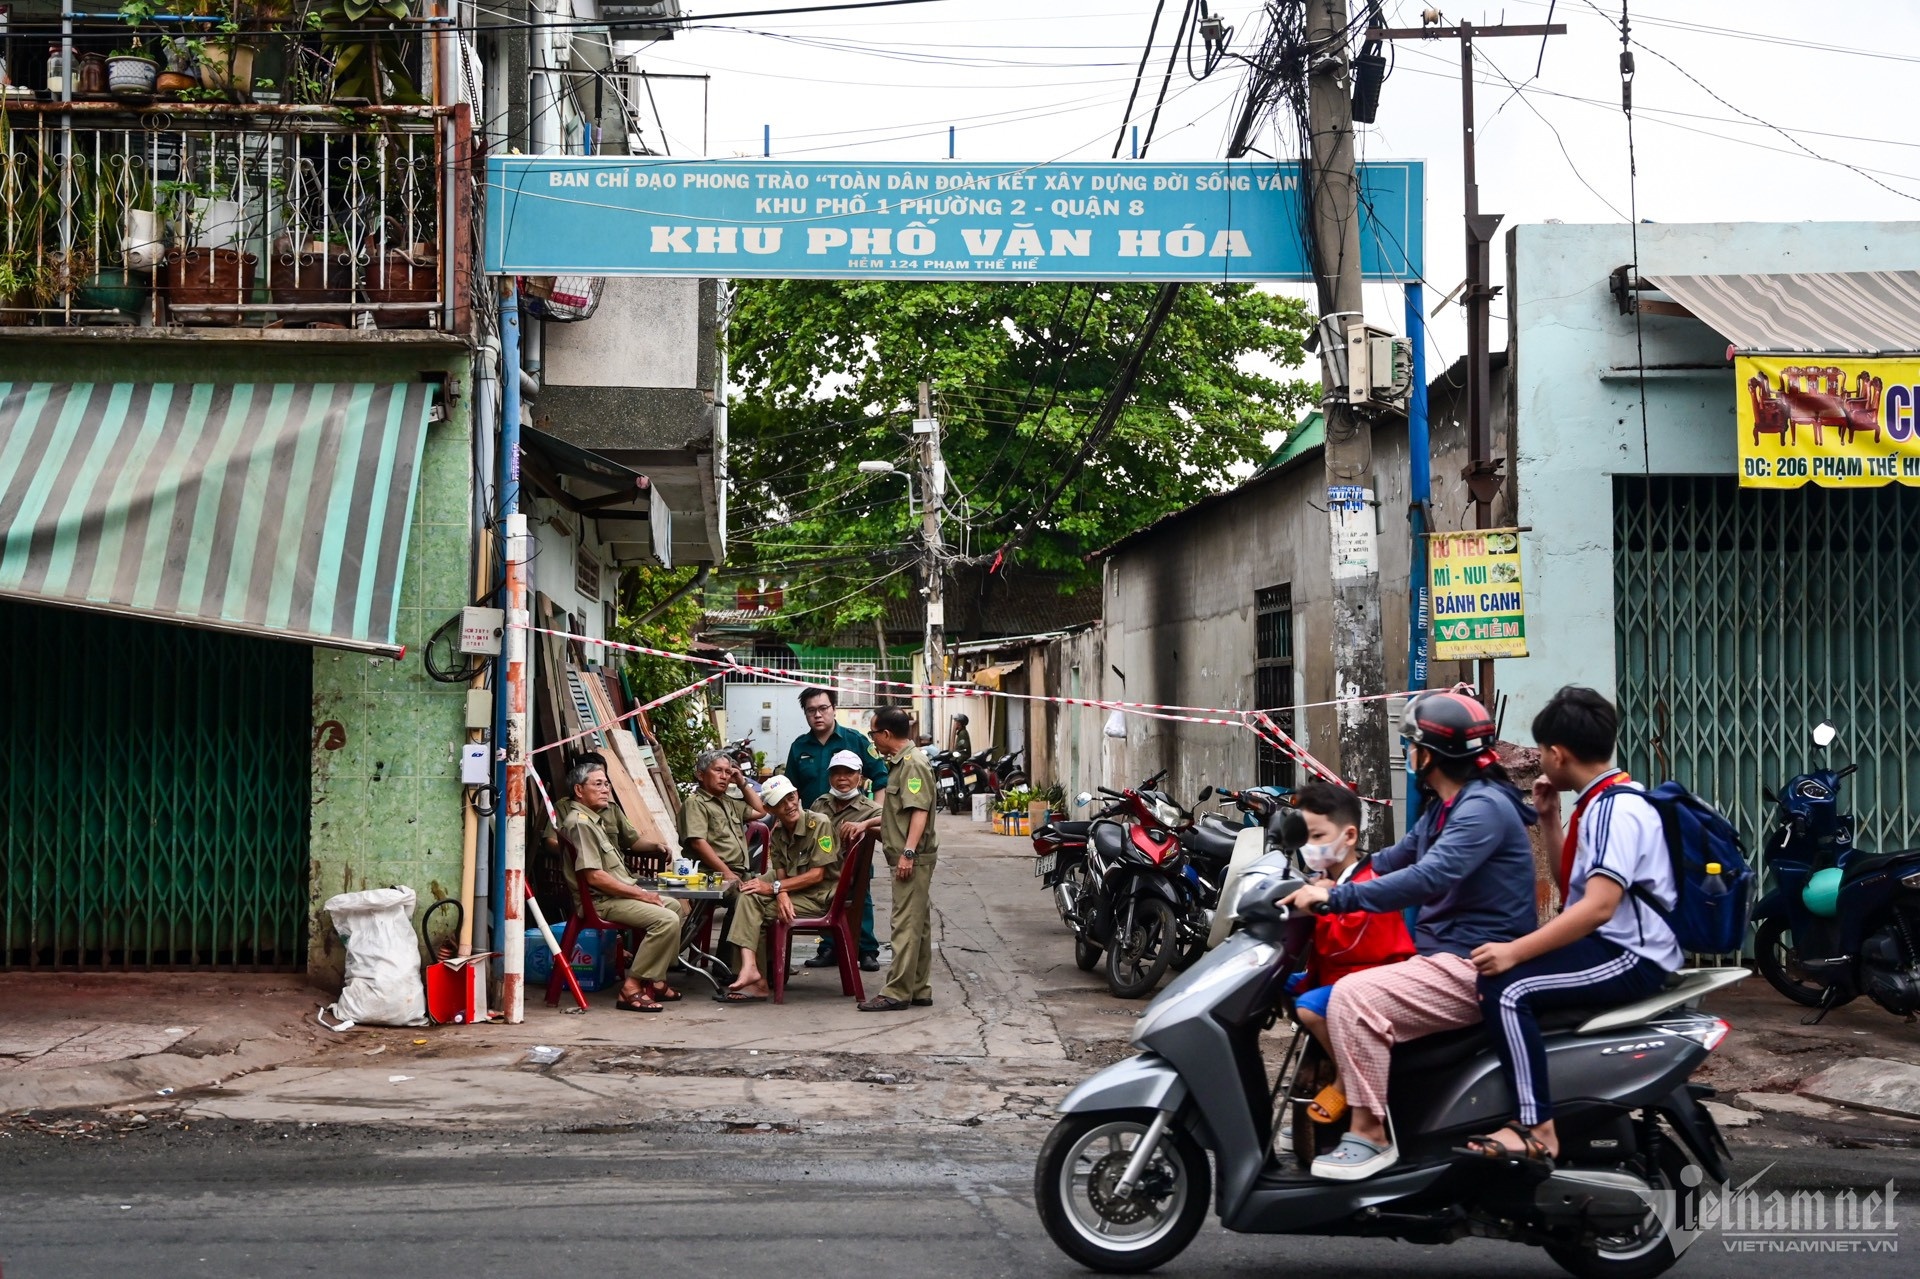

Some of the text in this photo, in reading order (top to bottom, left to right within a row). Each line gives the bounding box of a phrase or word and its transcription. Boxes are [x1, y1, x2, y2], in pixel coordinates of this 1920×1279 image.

[549, 172, 589, 187] BAN
[595, 168, 630, 188] CHỈ
[635, 173, 677, 191] ĐẠO
[683, 173, 749, 189] PHONG
[755, 170, 809, 190] TRÀO
[887, 171, 928, 190] DÂN
[935, 171, 990, 191] ĐOÀN
[997, 169, 1038, 191] KẾT
[1044, 171, 1084, 191] XÂY
[1091, 173, 1147, 193] DỰNG
[1153, 172, 1188, 191] ĐỜI
[1195, 170, 1250, 191] SỐNG
[755, 198, 807, 214] KHU
[816, 192, 869, 215] PHỐ
[877, 198, 890, 215] 1
[900, 195, 1002, 215] PHƯỜNG
[1010, 199, 1026, 215] 2
[1051, 195, 1120, 219] QUẬN
[1128, 199, 1144, 216] 8
[650, 218, 1252, 257] KHU PHỐ VĂN HÓA
[889, 260, 918, 269] 124
[923, 260, 969, 270] PHẠM
[974, 258, 1007, 269] THẾ
[1745, 457, 1771, 476] ĐC:
[1776, 457, 1807, 476] 206
[1812, 457, 1862, 480] PHẠM
[1867, 451, 1899, 476] THẾ
[1434, 564, 1450, 586] MÌ
[1463, 566, 1487, 585] NUI
[1435, 592, 1475, 614] BÁNH
[1480, 592, 1520, 612] CANH
[1475, 618, 1519, 638] HẺM
